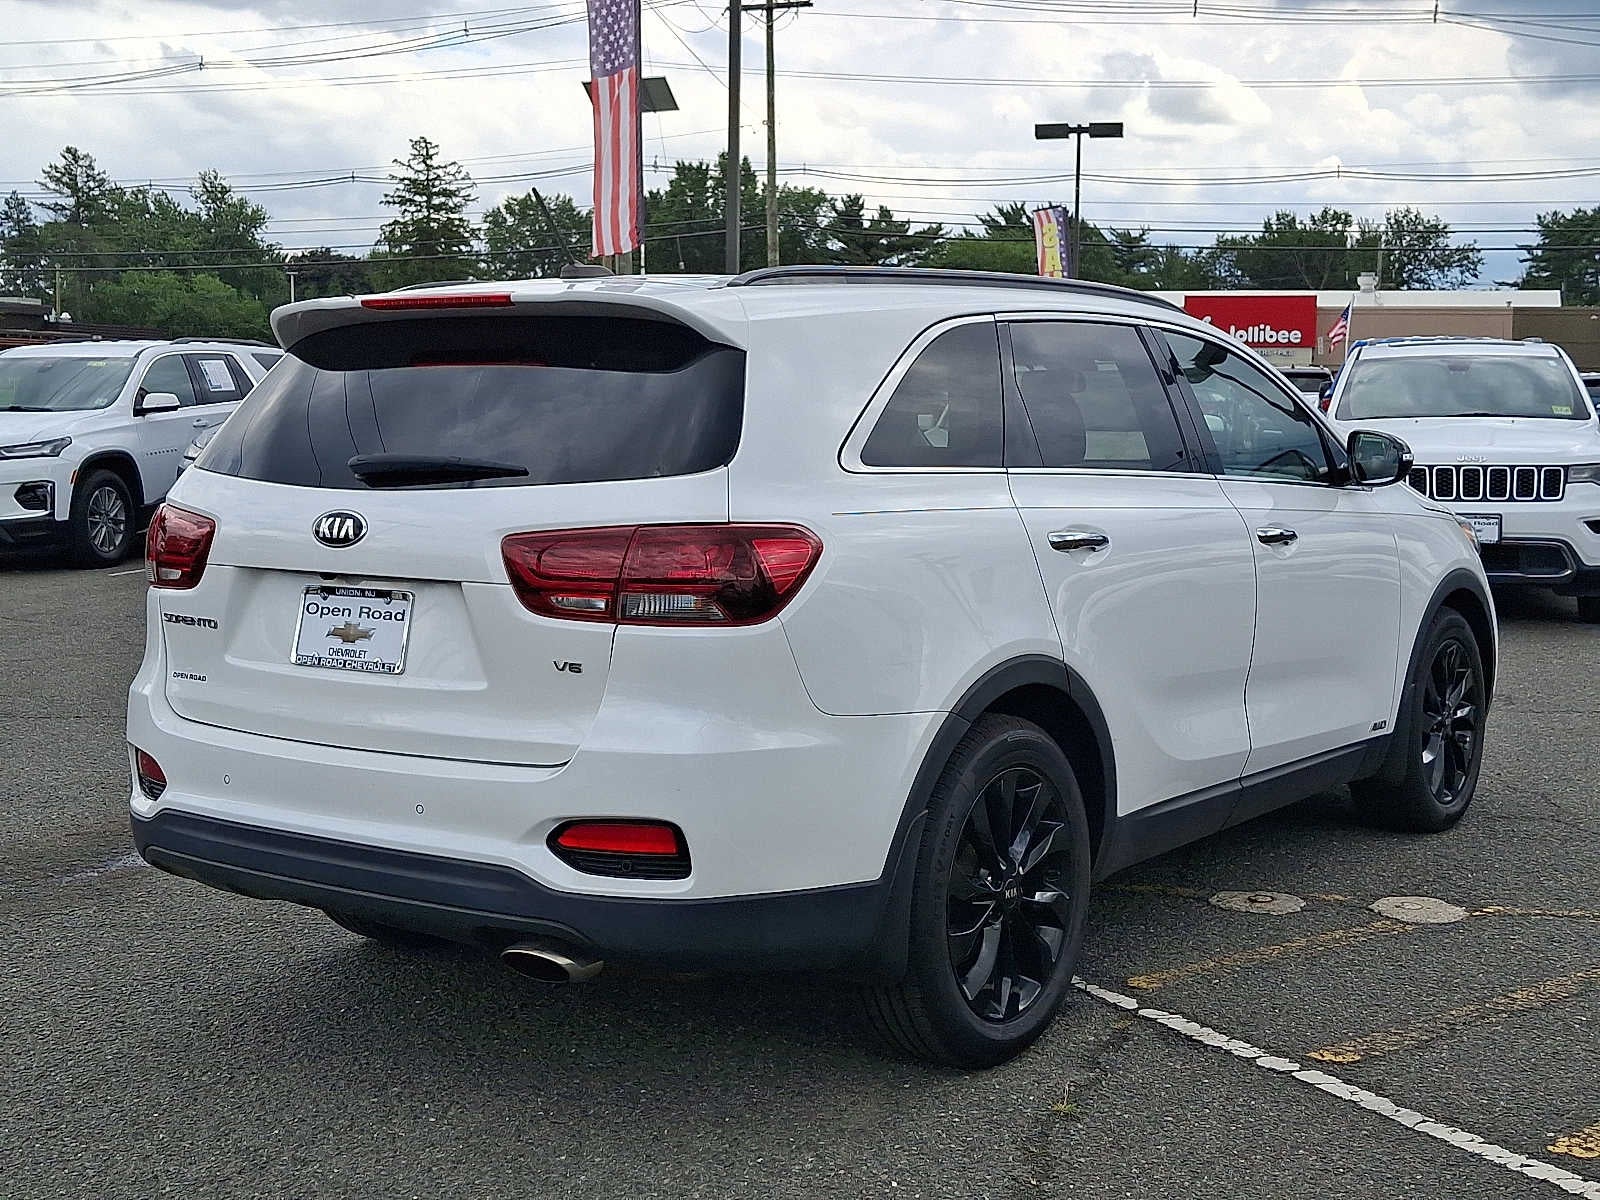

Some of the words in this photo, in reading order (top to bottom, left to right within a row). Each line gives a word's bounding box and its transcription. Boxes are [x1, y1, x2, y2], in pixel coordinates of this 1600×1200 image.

[1229, 323, 1302, 343] Jollibee
[1456, 455, 1488, 463] Jeep
[319, 517, 354, 539] KIA
[365, 589, 376, 598] NJ
[305, 602, 352, 619] Open
[358, 606, 406, 621] Road
[163, 612, 219, 629] SORENTO
[328, 647, 368, 660] CHEVROLET
[296, 655, 319, 666] OPEN
[321, 657, 344, 667] ROAD
[345, 659, 395, 672] CHEVROLET
[552, 660, 583, 674] V6
[172, 671, 188, 680] OPEN
[189, 673, 207, 682] ROAD
